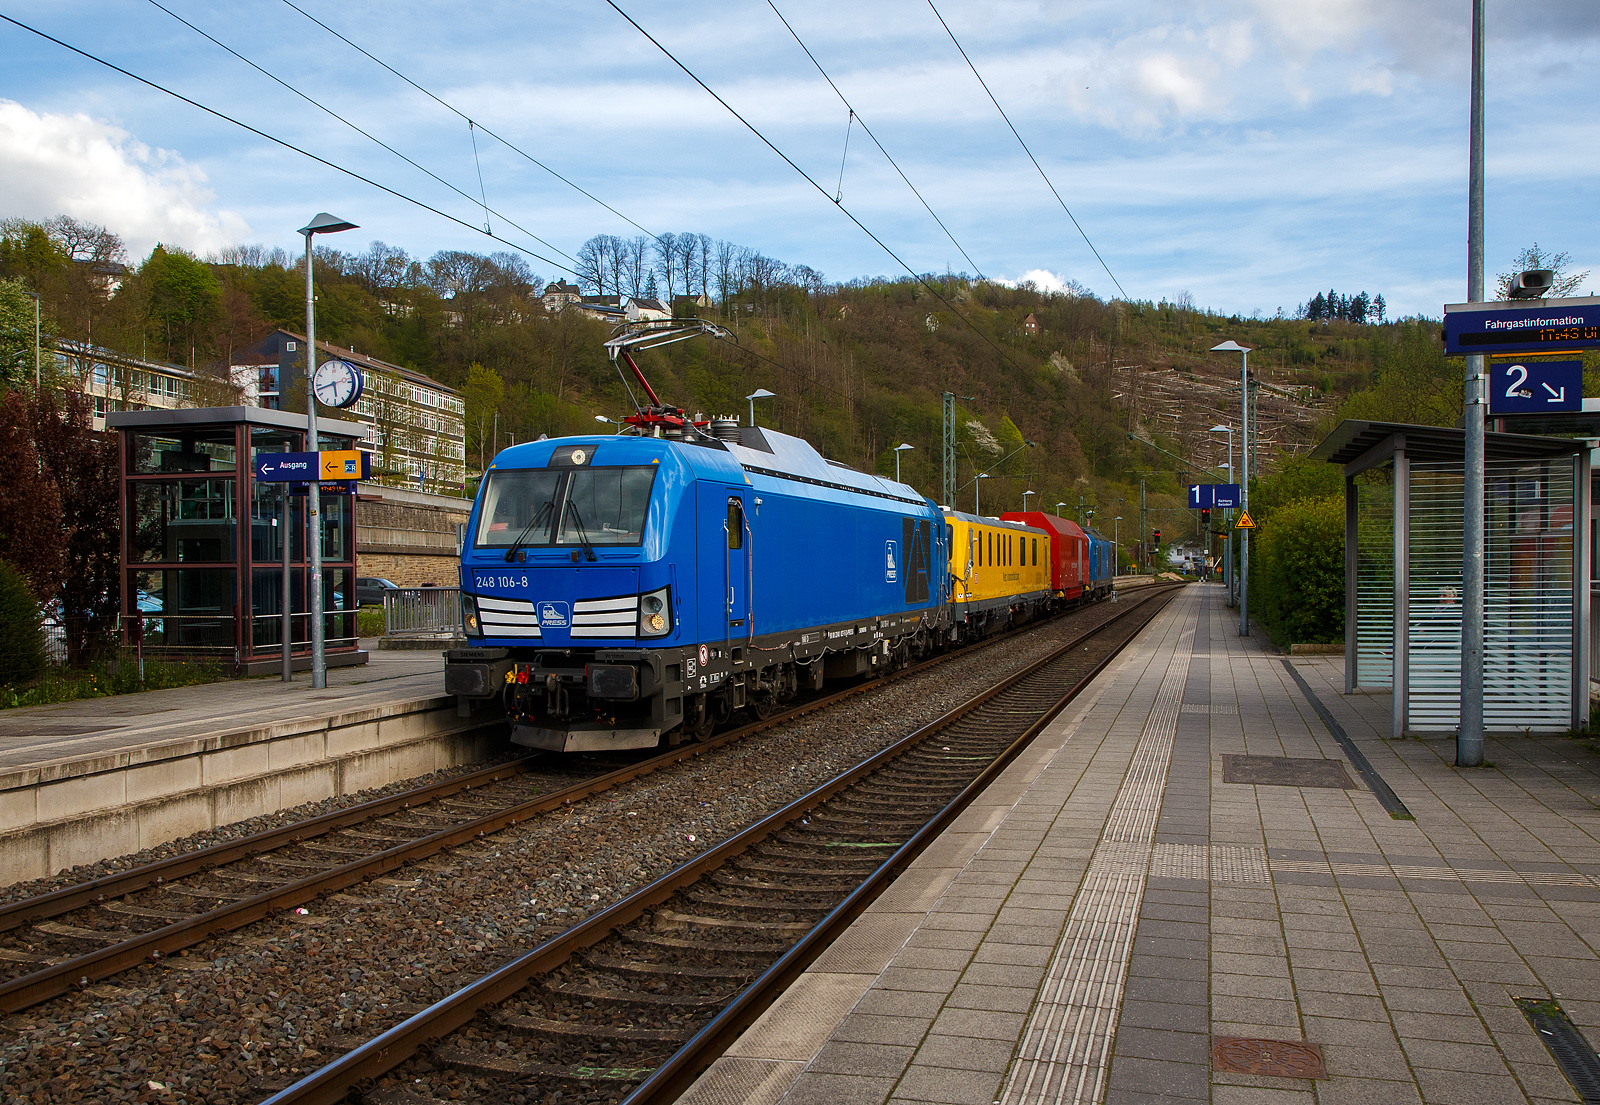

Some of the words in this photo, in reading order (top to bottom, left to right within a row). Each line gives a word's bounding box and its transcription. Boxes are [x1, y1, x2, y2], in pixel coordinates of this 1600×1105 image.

[1485, 316, 1584, 330] Fahrgastinformation
[1539, 328, 1580, 341] 17:43
[1505, 365, 1529, 398] 2
[280, 461, 307, 470] Ausgang
[1191, 485, 1200, 503] 1
[476, 576, 495, 588] 248
[498, 576, 529, 588] 106-8
